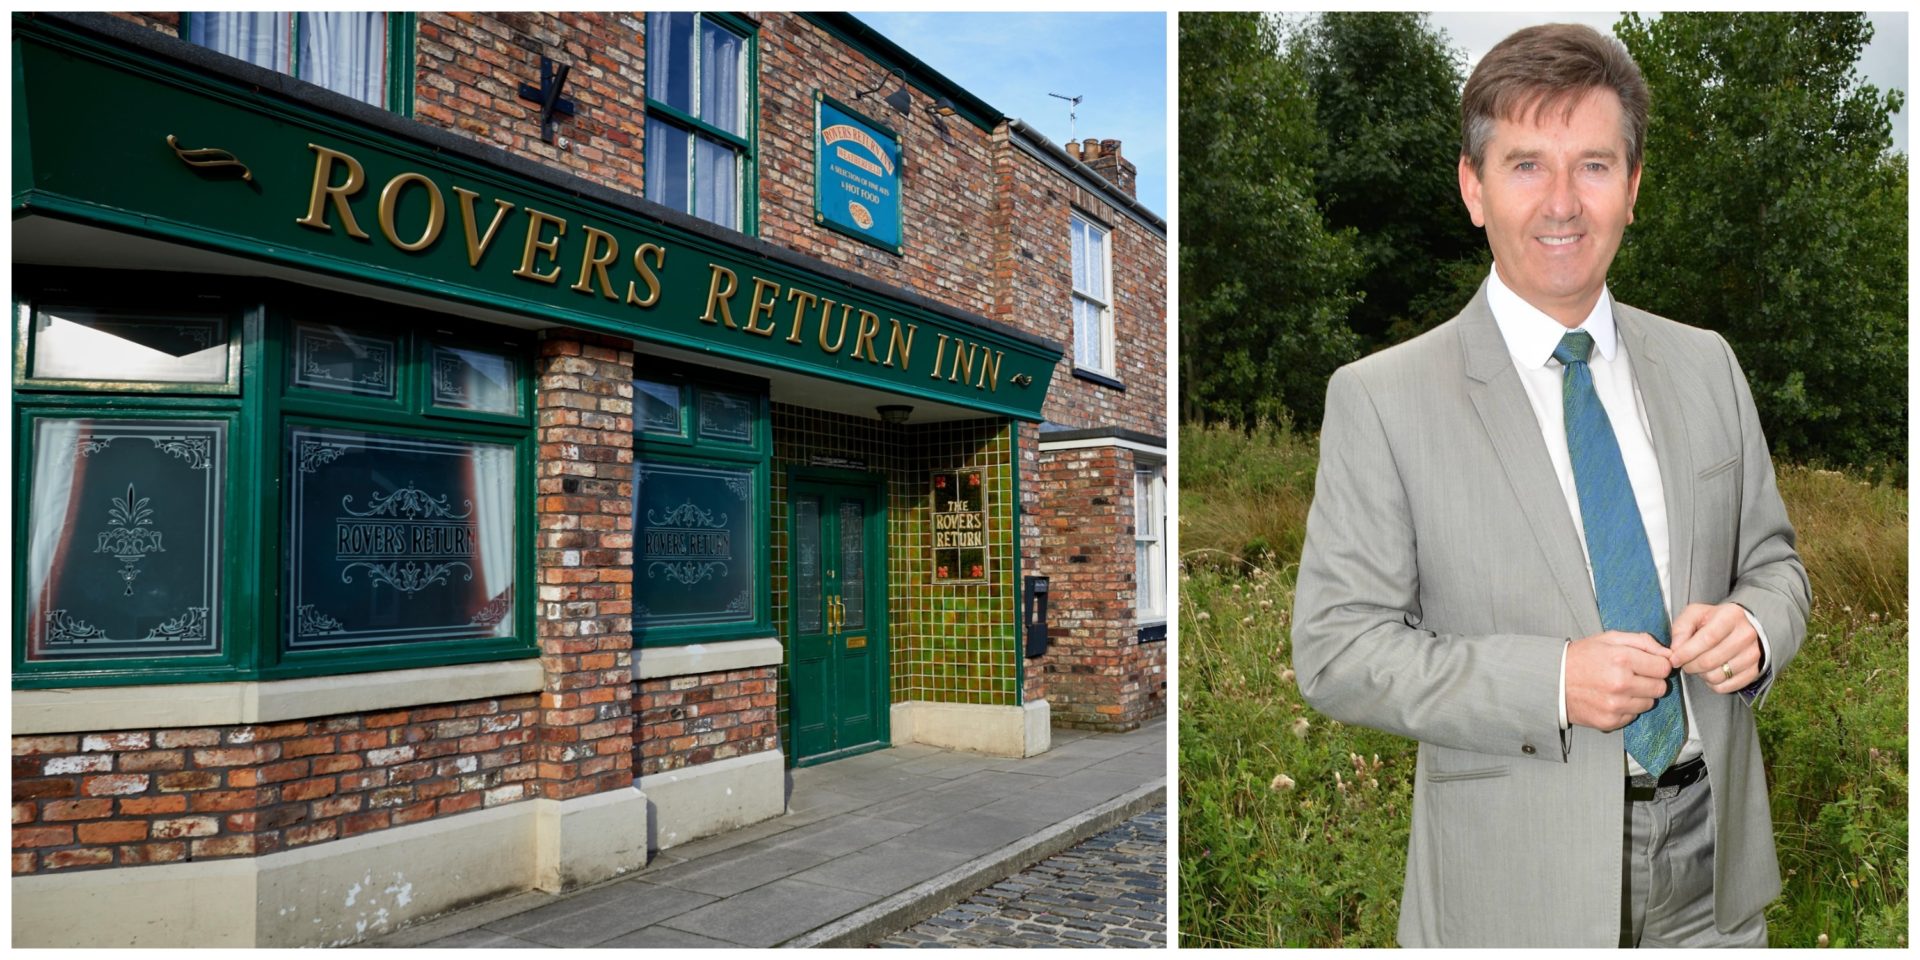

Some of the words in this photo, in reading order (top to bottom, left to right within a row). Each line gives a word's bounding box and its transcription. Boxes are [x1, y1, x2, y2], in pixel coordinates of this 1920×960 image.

[823, 126, 852, 144] ROVERS
[852, 129, 882, 156] RETURN
[835, 165, 860, 183] SELECTION
[861, 178, 868, 186] OF
[845, 182, 860, 196] HOT
[861, 189, 880, 204] FOOD
[296, 143, 665, 307] ROVERS
[700, 263, 918, 370] RETURN
[931, 333, 1004, 392] INN
[948, 501, 968, 511] THE
[936, 513, 981, 530] ROVERS
[337, 524, 406, 554] ROVERS
[411, 526, 477, 554] RETURN
[645, 532, 686, 554] ROVERS
[690, 533, 729, 555] RETURN
[937, 531, 982, 547] RETURN
